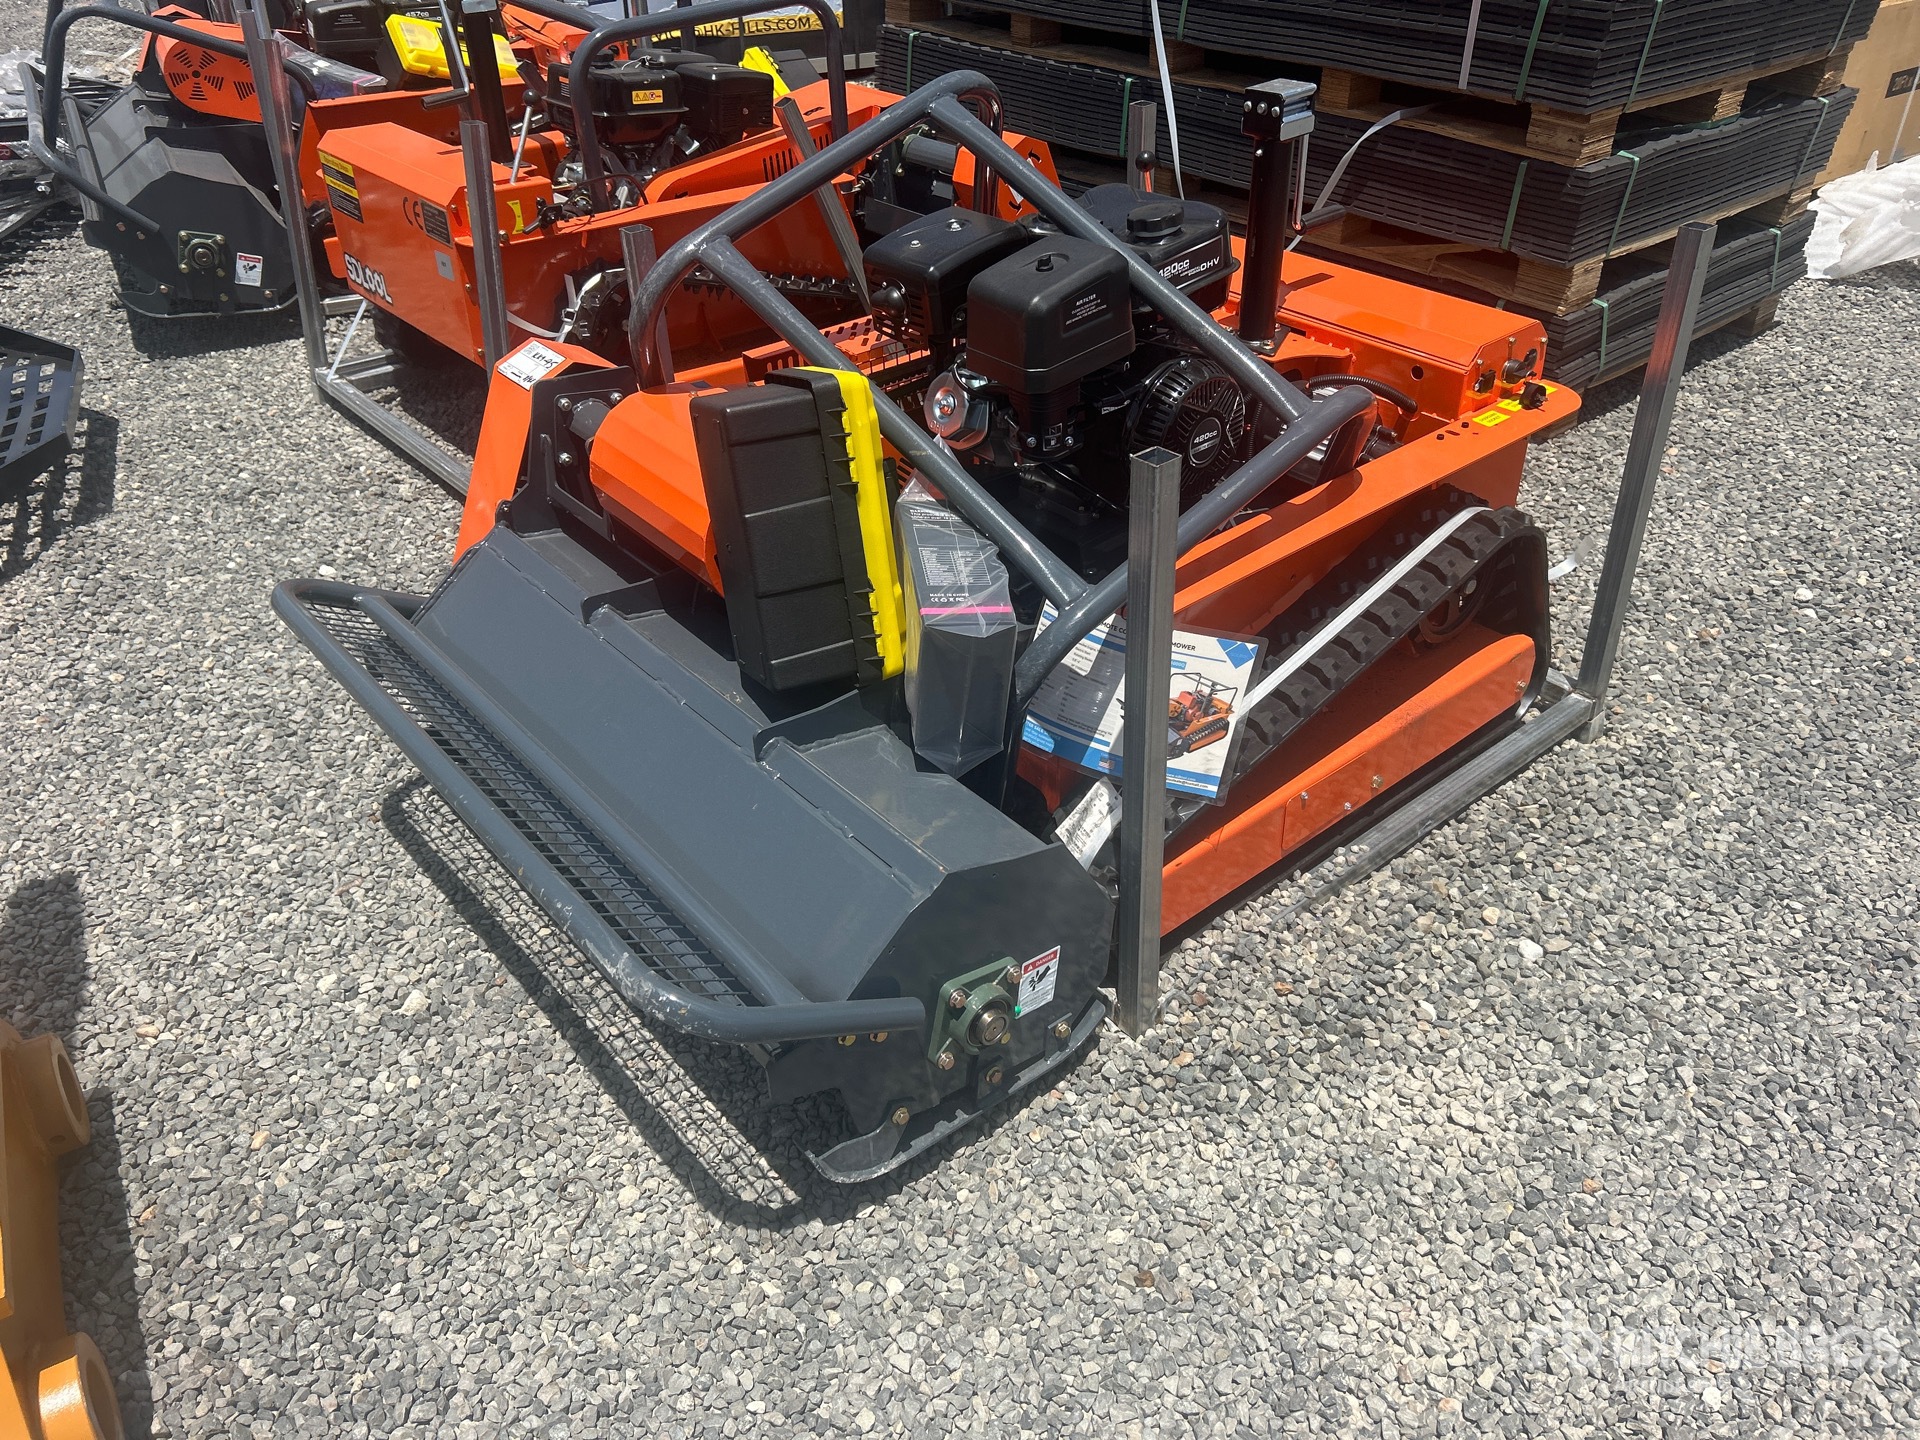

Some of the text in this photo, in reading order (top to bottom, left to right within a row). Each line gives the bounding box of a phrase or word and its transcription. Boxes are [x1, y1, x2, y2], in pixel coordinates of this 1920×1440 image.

[1200, 256, 1220, 271] OHV
[1193, 430, 1218, 443] 420cc
[1172, 642, 1196, 652] MOWER
[1035, 953, 1055, 967] DANGER
